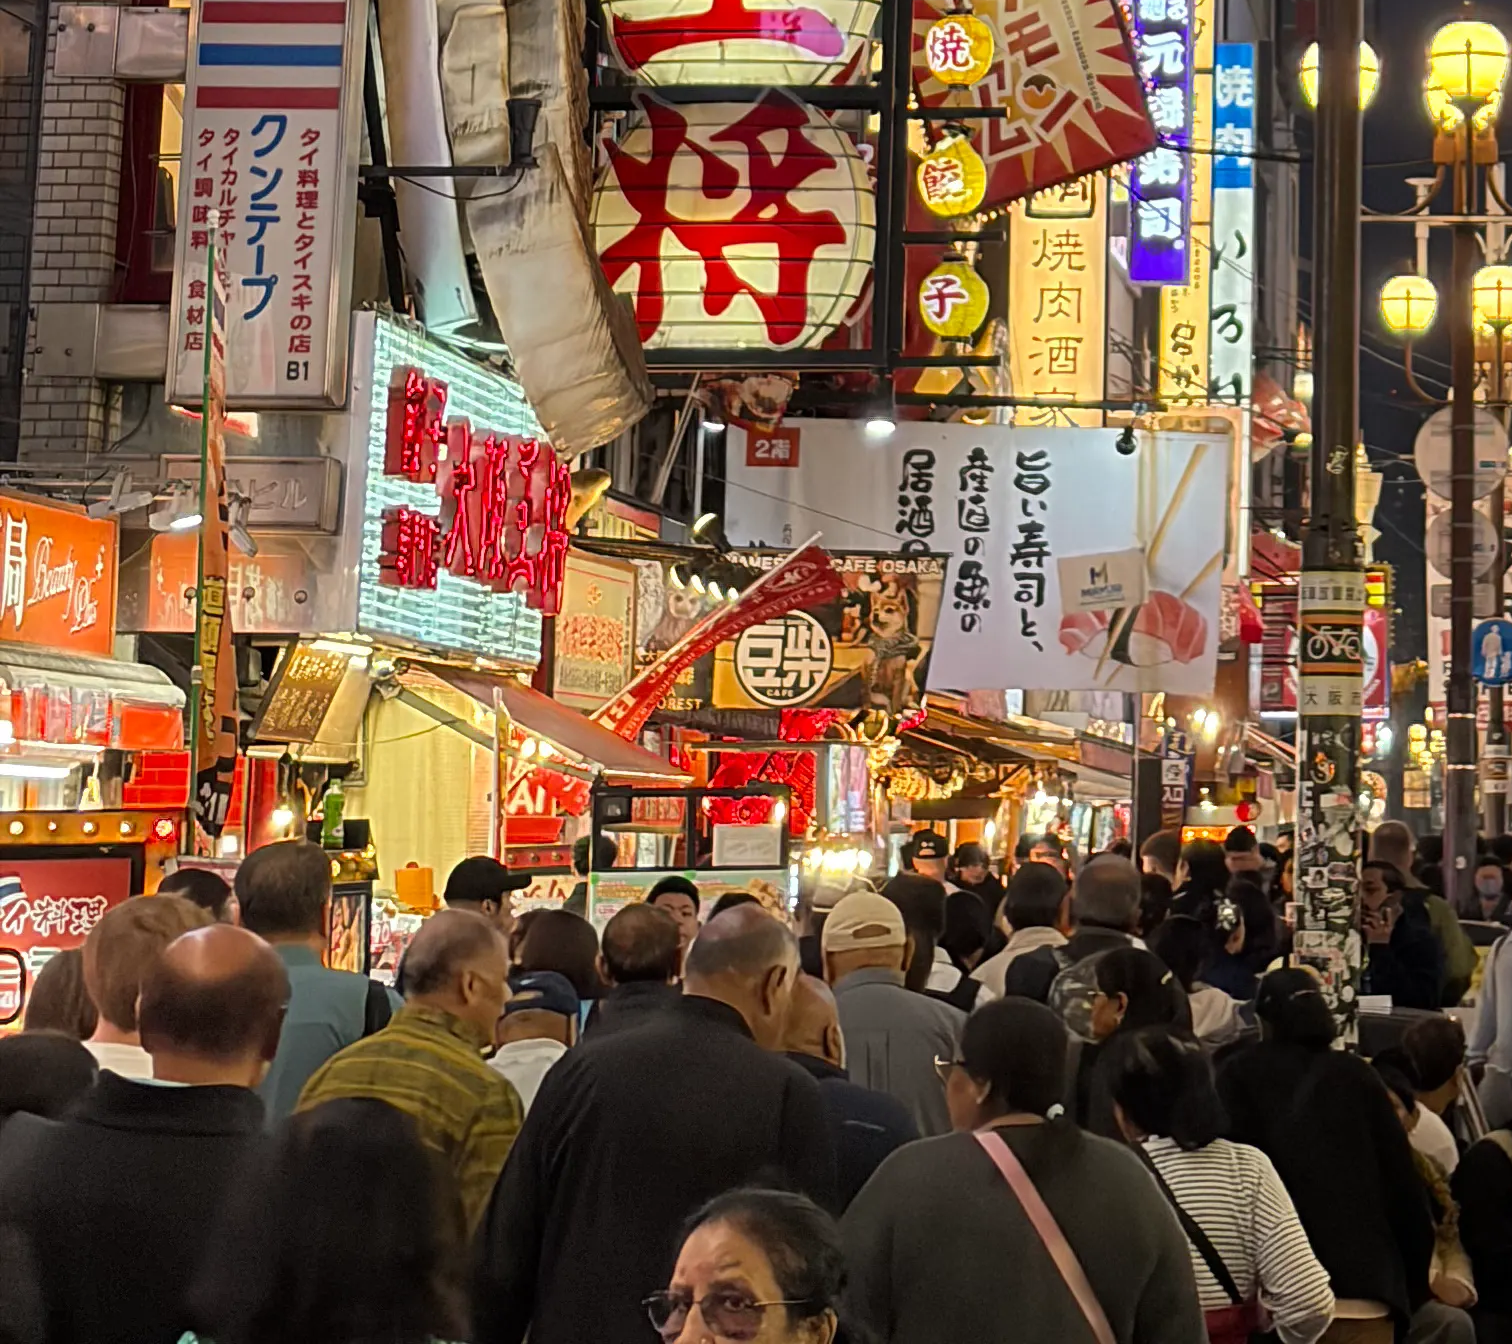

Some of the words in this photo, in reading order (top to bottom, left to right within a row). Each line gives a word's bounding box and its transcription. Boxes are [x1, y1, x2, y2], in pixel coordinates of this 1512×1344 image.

[1215, 64, 1255, 164] 焼肉
[241, 115, 287, 320] クンテープ
[288, 128, 320, 354] タイ料理とタイスキの店
[185, 279, 206, 351] 食材店
[1028, 229, 1087, 428] 焼肉酒家
[286, 361, 309, 381] B1
[755, 439, 791, 459] 2階
[831, 557, 876, 574] CAFE
[881, 558, 941, 574] OSAKA
[953, 446, 994, 634] 産直の魚の
[656, 698, 703, 711] OREST
[1162, 786, 1184, 803] 入口
